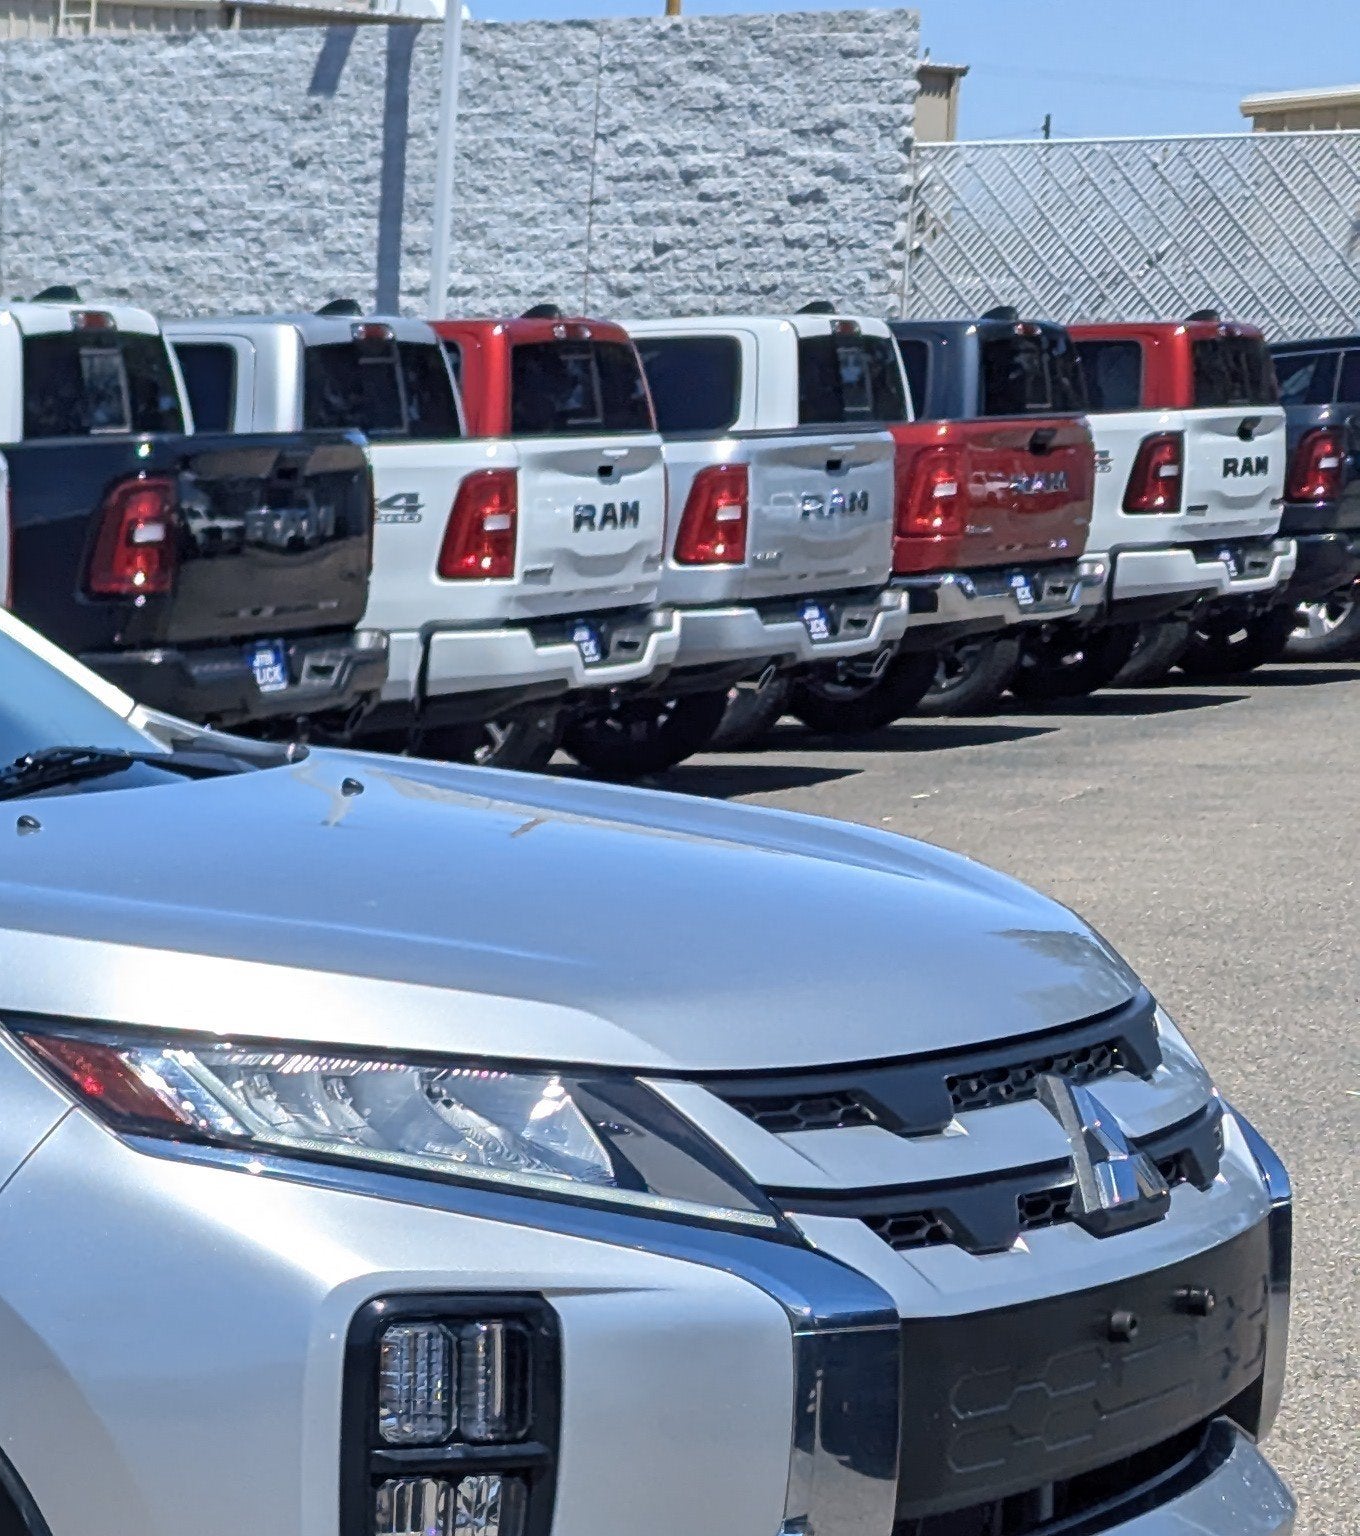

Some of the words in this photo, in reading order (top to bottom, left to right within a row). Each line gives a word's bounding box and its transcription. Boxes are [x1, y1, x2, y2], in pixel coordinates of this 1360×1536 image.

[1222, 456, 1269, 477] RAM
[573, 500, 640, 533] RAM
[801, 490, 868, 520] RAM
